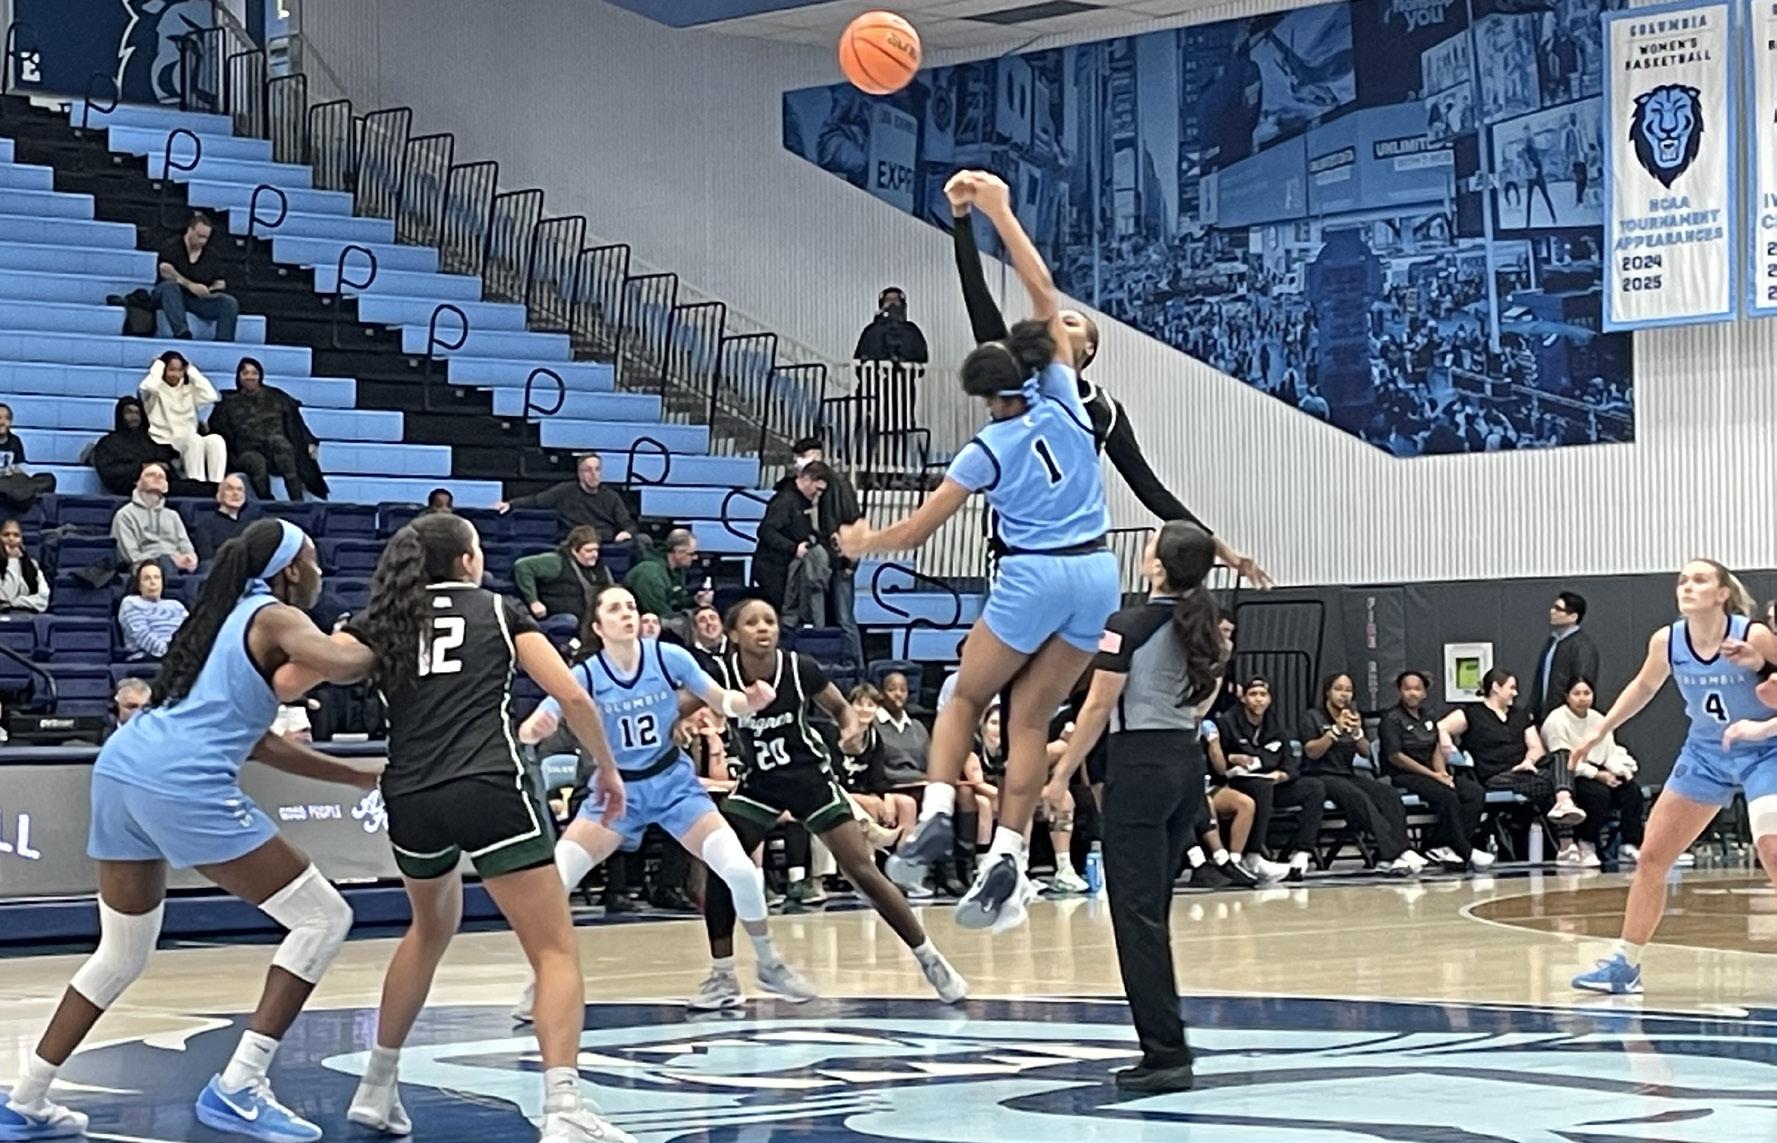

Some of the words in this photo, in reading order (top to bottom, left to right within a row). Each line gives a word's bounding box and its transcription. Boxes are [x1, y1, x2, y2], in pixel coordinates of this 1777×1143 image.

[1404, 6, 1444, 33] you
[1629, 15, 1707, 37] COLUMBIA
[1639, 37, 1698, 55] WOMEN'S
[1625, 50, 1711, 71] BASKETBALL
[1649, 196, 1691, 212] NCAA
[1619, 209, 1721, 233] TOURNAMENT
[1614, 227, 1724, 251] APPEARANCES
[1622, 254, 1662, 271] 2024
[1622, 275, 1662, 292] 2025
[1031, 435, 1064, 489] 1
[1682, 674, 1745, 686] OLUMBIA
[604, 691, 668, 714] OLUMBIA
[1704, 691, 1730, 723] 4
[618, 713, 661, 751] 12
[753, 737, 791, 770] 20
